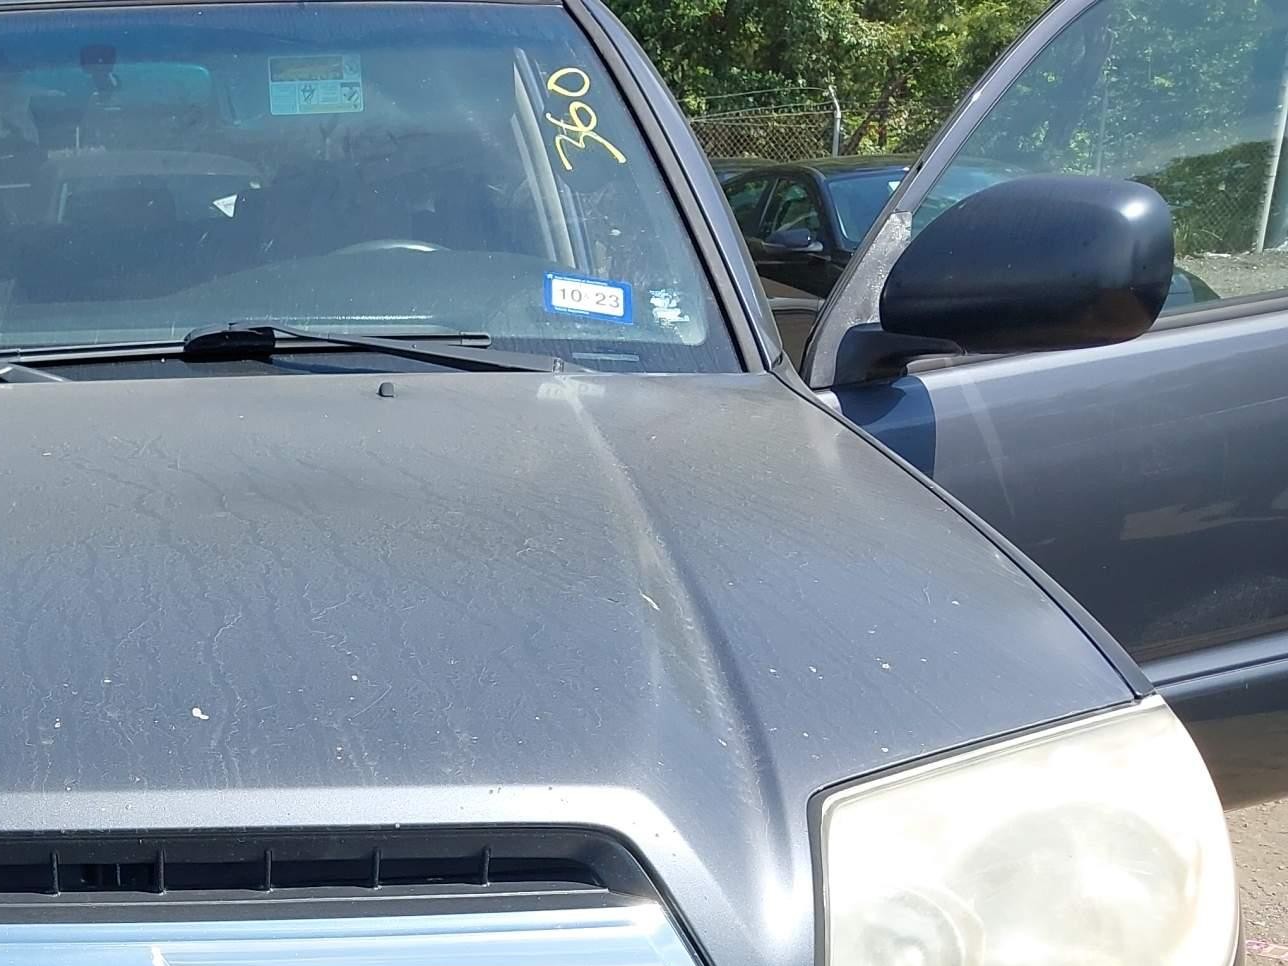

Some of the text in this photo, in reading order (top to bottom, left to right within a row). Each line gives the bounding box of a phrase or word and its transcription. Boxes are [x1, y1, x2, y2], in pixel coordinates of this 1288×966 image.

[546, 67, 627, 171] 360
[559, 287, 620, 309] 10 23
